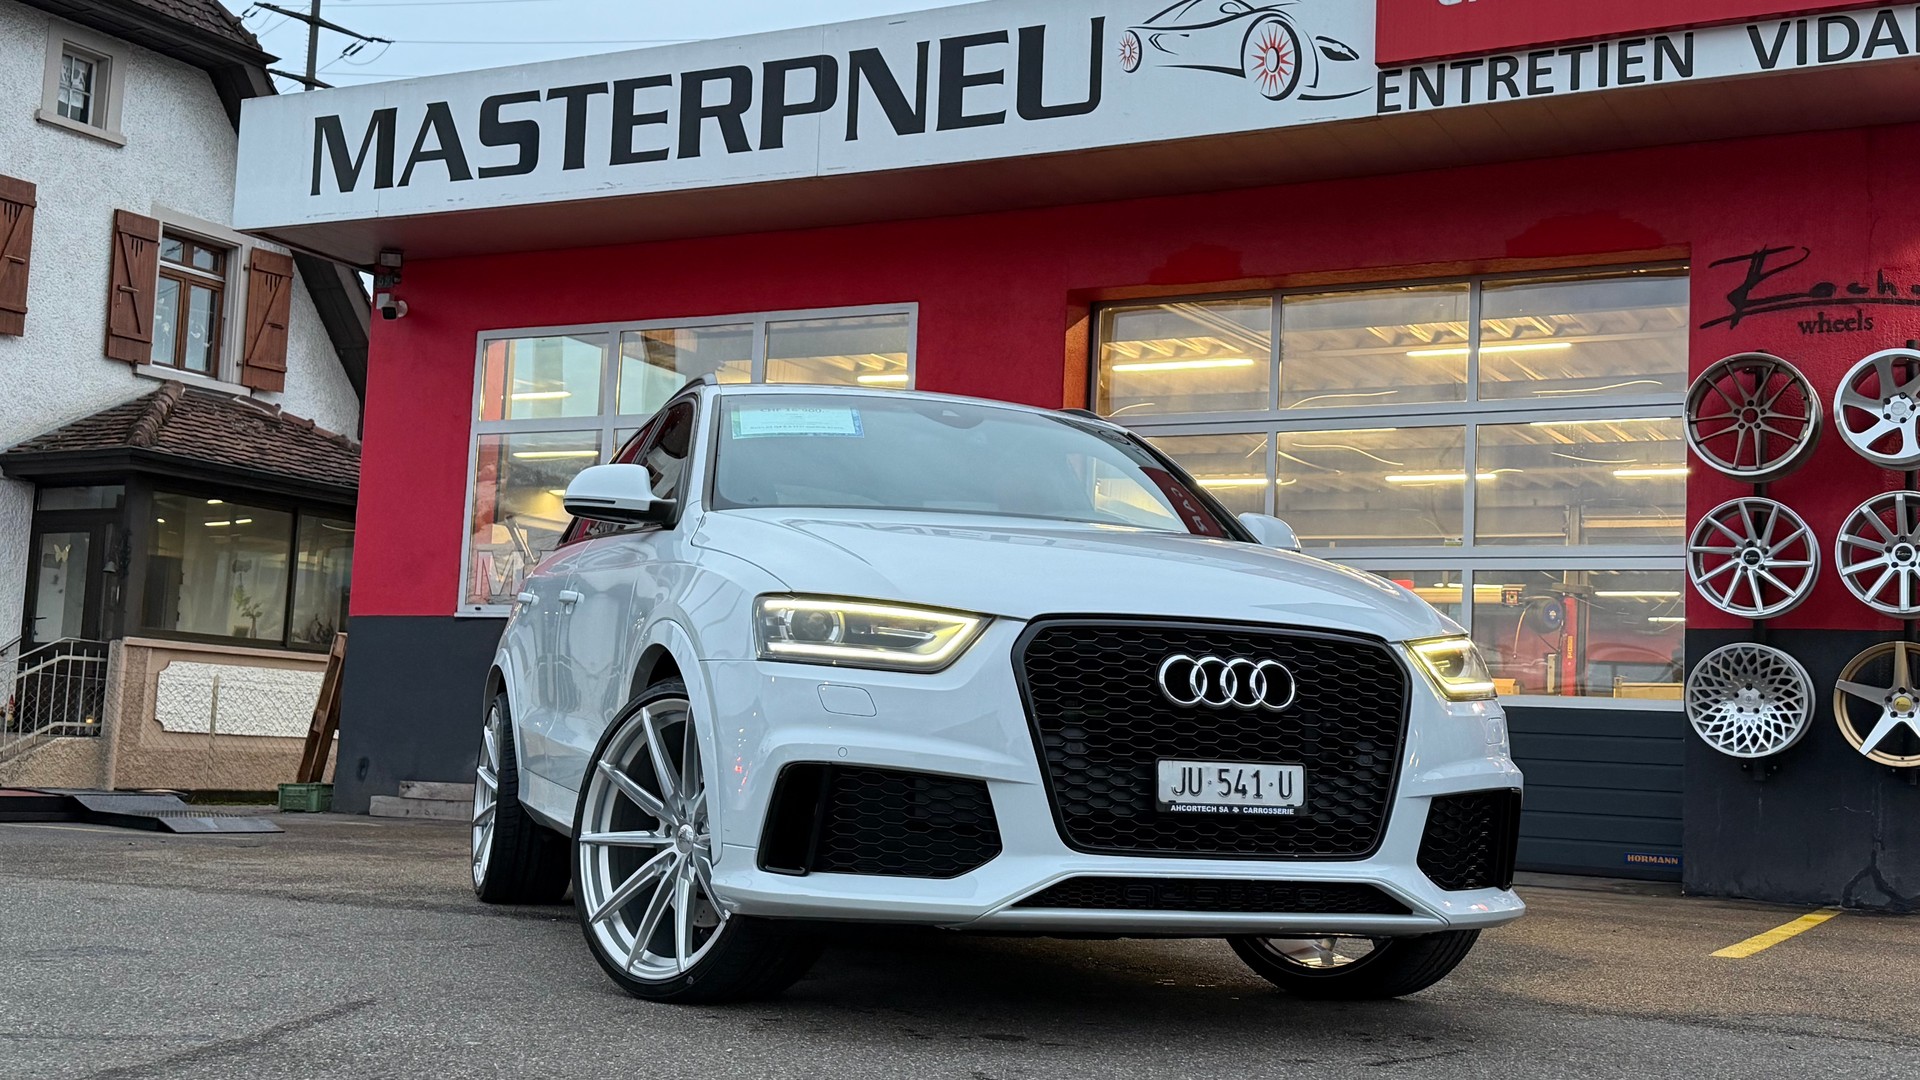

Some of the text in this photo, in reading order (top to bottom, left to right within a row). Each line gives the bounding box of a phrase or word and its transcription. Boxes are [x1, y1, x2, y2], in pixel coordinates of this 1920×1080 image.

[1377, 6, 1920, 114] ENTRETIEN VIDA
[310, 16, 1105, 196] MASTERPNEU
[1798, 309, 1874, 335] wheels
[1170, 804, 1295, 815] AHCORTECH SA CARROSSERIE
